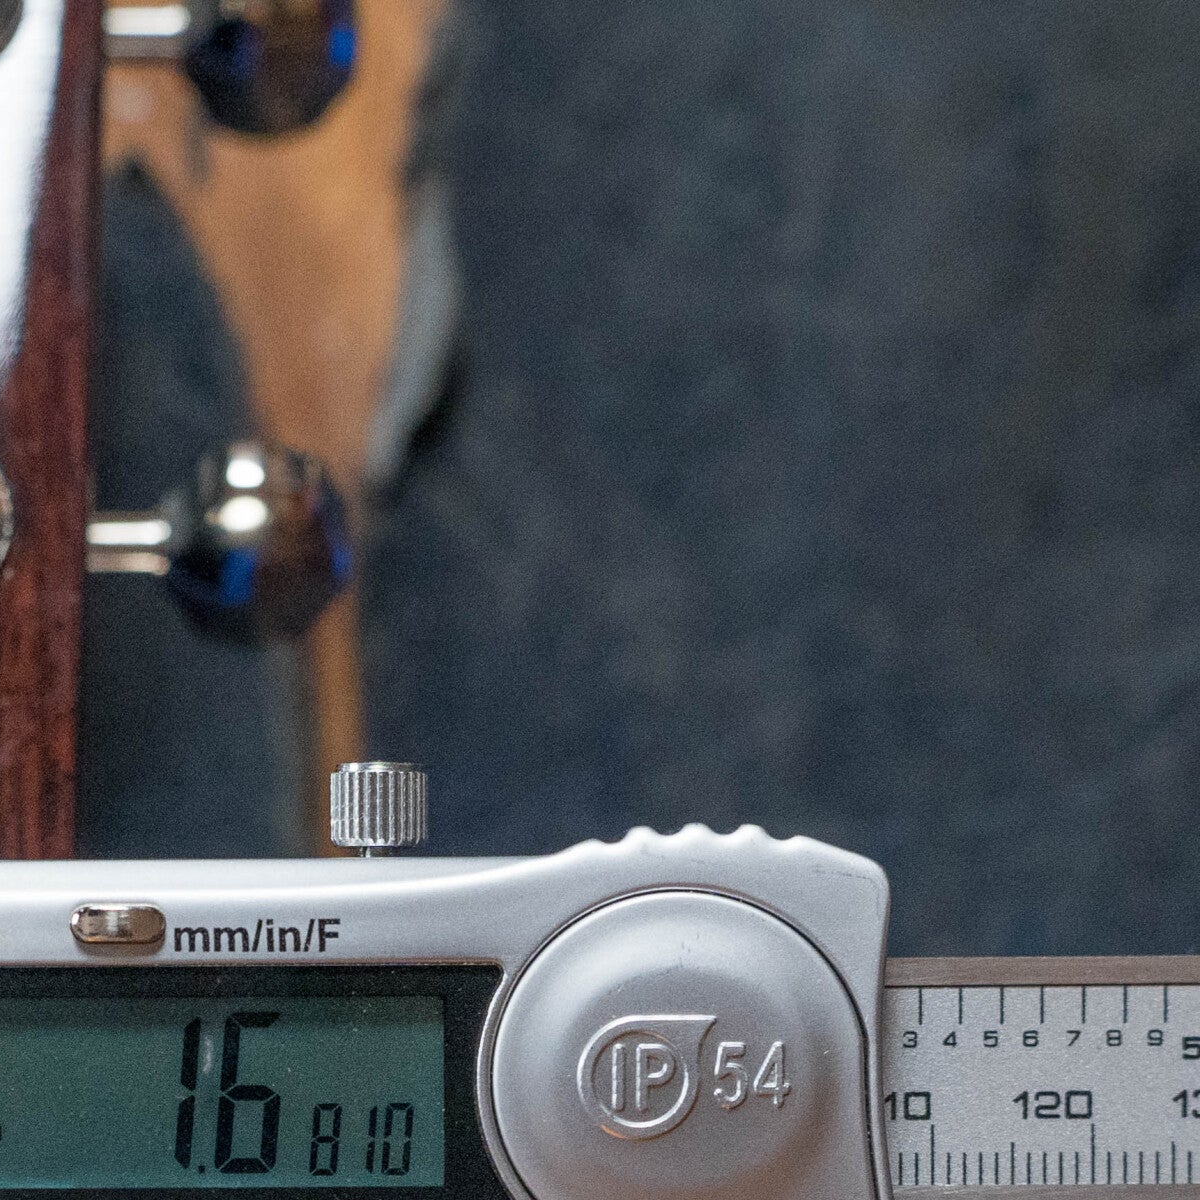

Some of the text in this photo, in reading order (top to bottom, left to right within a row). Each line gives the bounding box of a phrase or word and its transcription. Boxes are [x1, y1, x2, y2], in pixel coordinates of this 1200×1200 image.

[173, 918, 341, 953] mm/in/F
[903, 1031, 918, 1048] 3
[943, 1031, 958, 1047] 4
[984, 1031, 999, 1047] 5
[1023, 1030, 1039, 1047] 6
[1067, 1030, 1081, 1046] 7
[1106, 1030, 1122, 1046] 8
[1147, 1029, 1164, 1046] 9
[611, 1040, 791, 1112] IP 54
[1013, 1090, 1092, 1119] 120
